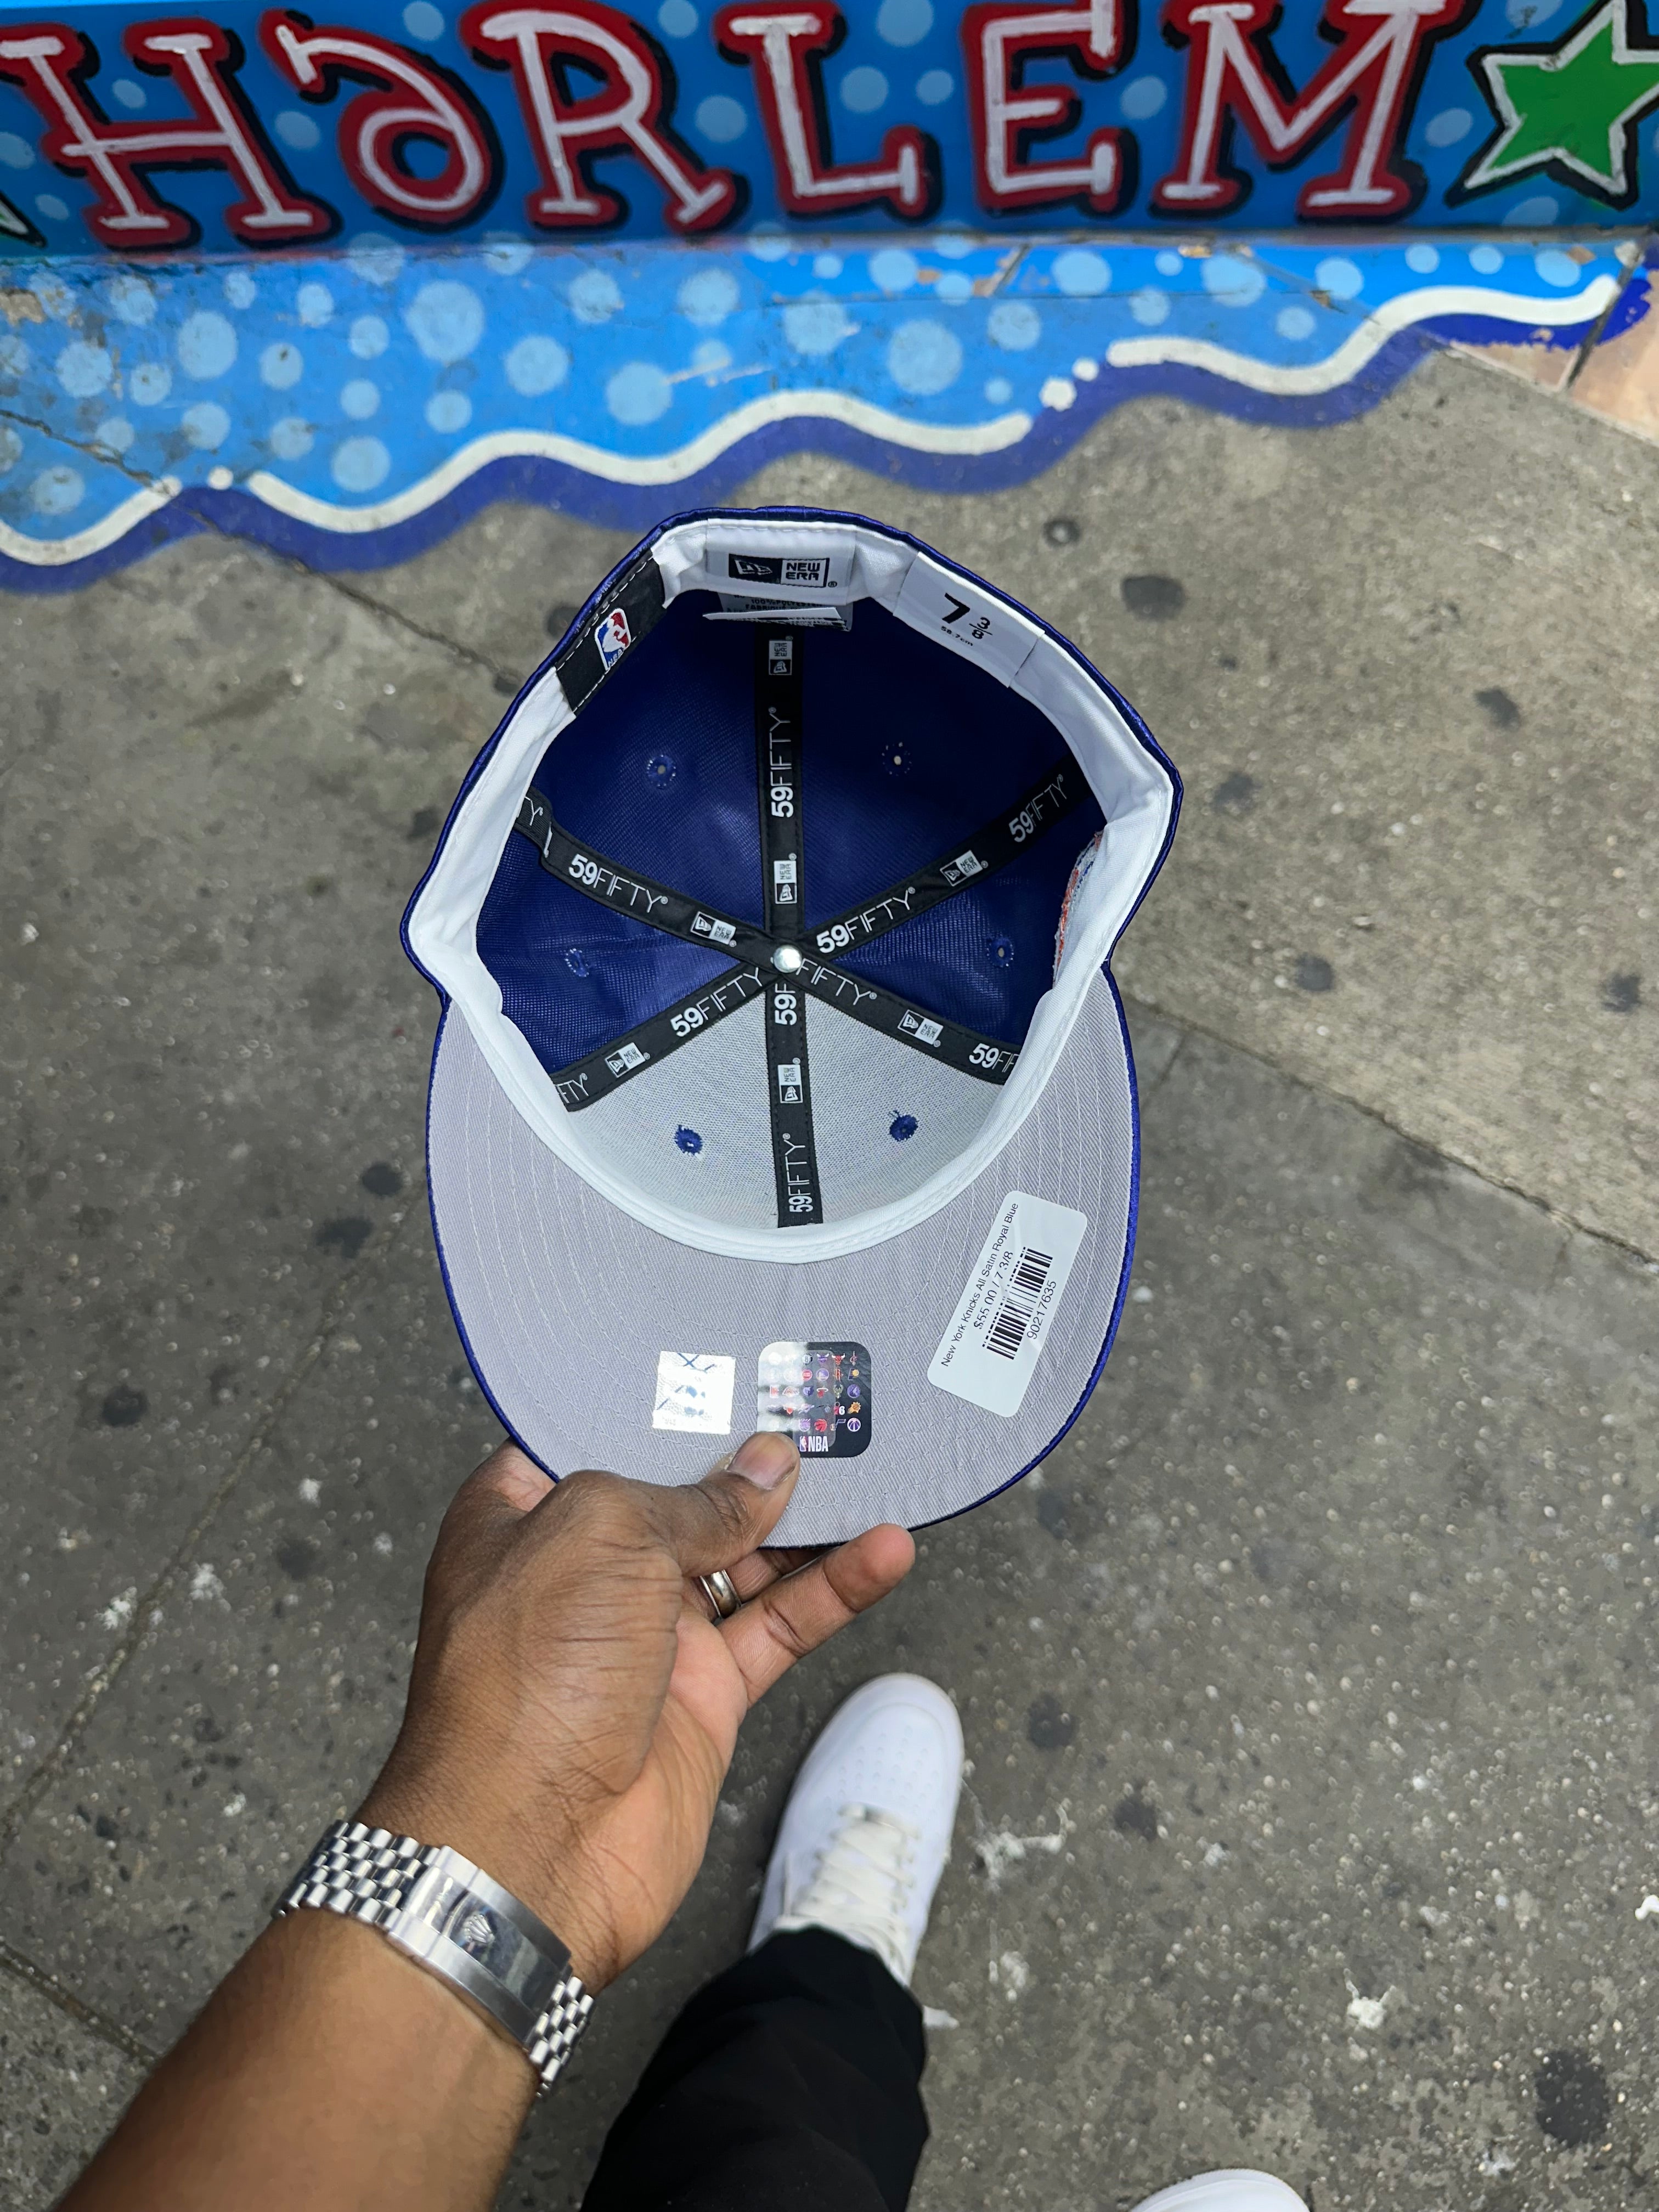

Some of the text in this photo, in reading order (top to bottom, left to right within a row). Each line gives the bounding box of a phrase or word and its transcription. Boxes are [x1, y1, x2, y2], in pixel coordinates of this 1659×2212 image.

[786, 562, 820, 572] NEW
[786, 572, 819, 580] ERA
[942, 592, 970, 624] 7
[994, 1271, 1003, 1279] 7
[999, 1251, 1013, 1270] 3/8
[941, 1203, 1018, 1367] New York Knicks All Satin Royal Blue
[1026, 1280, 1056, 1340] 90217635
[808, 1436, 829, 1452] NBA
